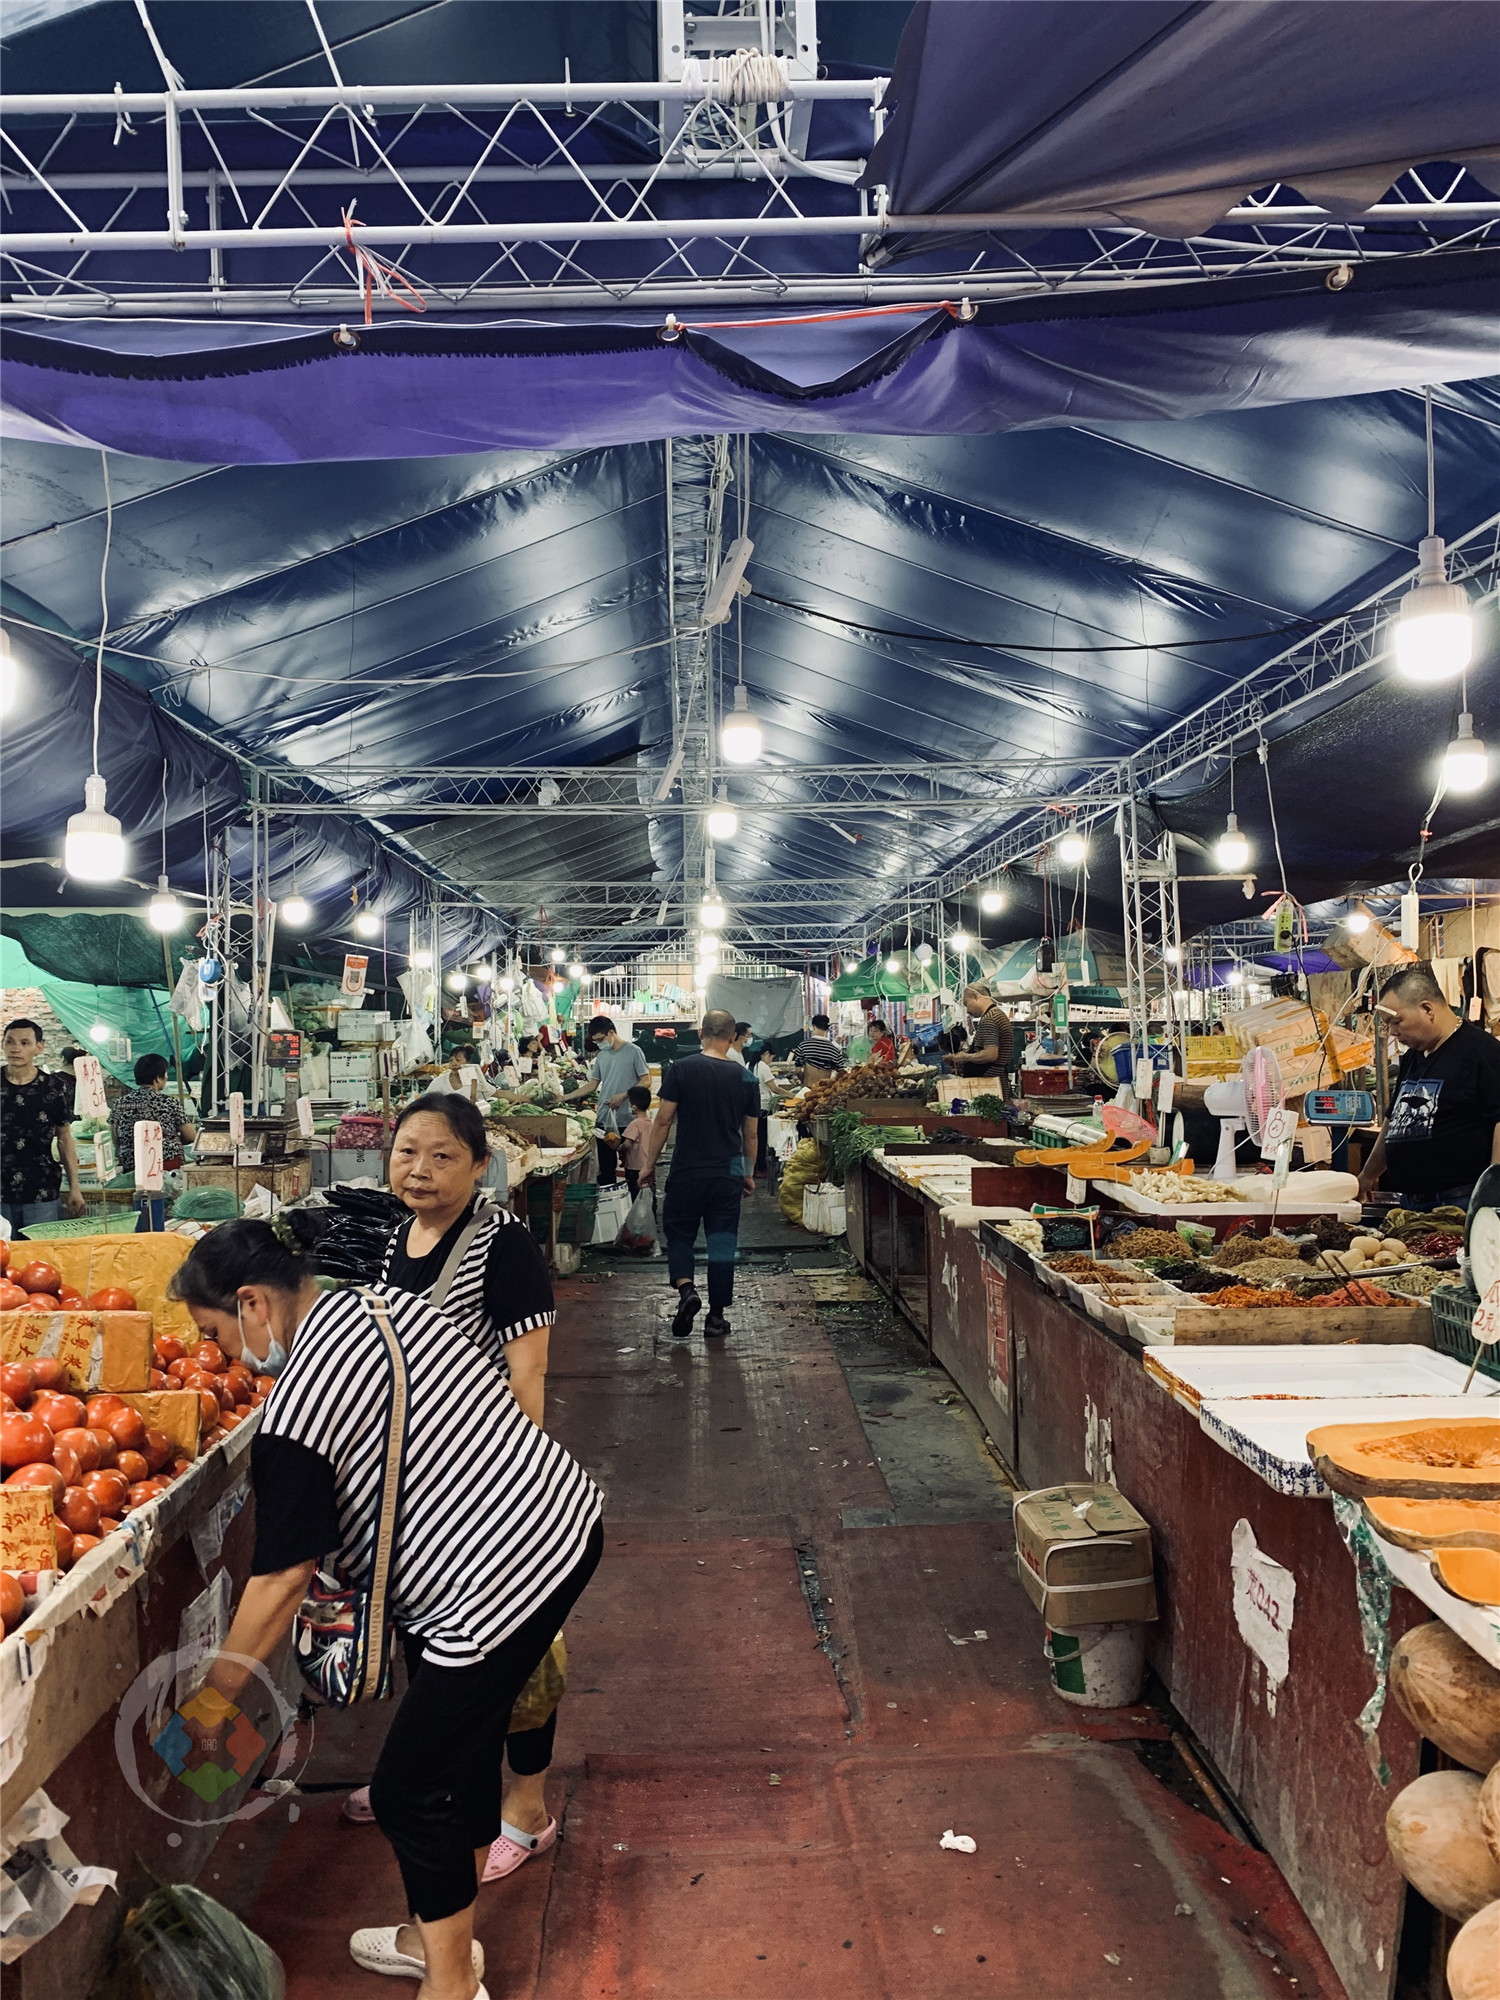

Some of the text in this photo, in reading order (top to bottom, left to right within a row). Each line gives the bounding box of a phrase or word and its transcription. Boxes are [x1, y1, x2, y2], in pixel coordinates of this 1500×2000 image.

[83, 1060, 100, 1079] 本地
[144, 1122, 162, 1146] 本地
[1474, 1308, 1494, 1333] 2元
[390, 1382, 404, 1443] Minigirl
